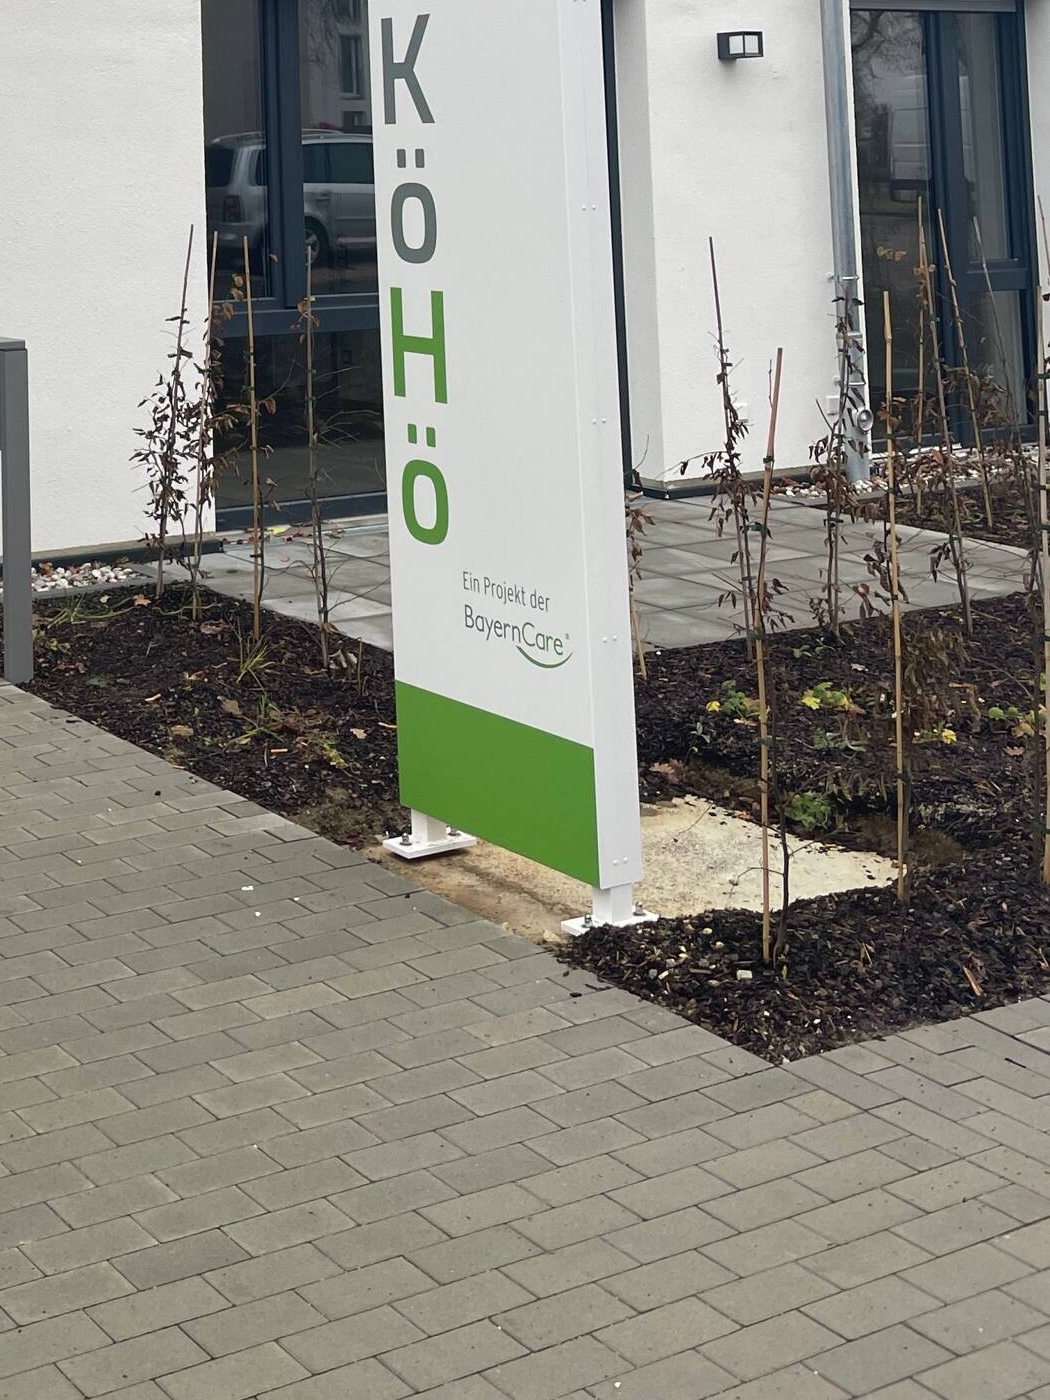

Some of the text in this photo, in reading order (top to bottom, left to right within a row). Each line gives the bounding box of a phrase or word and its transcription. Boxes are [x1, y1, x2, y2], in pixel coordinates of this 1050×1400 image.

[462, 570, 551, 612] Ein Projekt der
[464, 603, 564, 656] BayernCare
